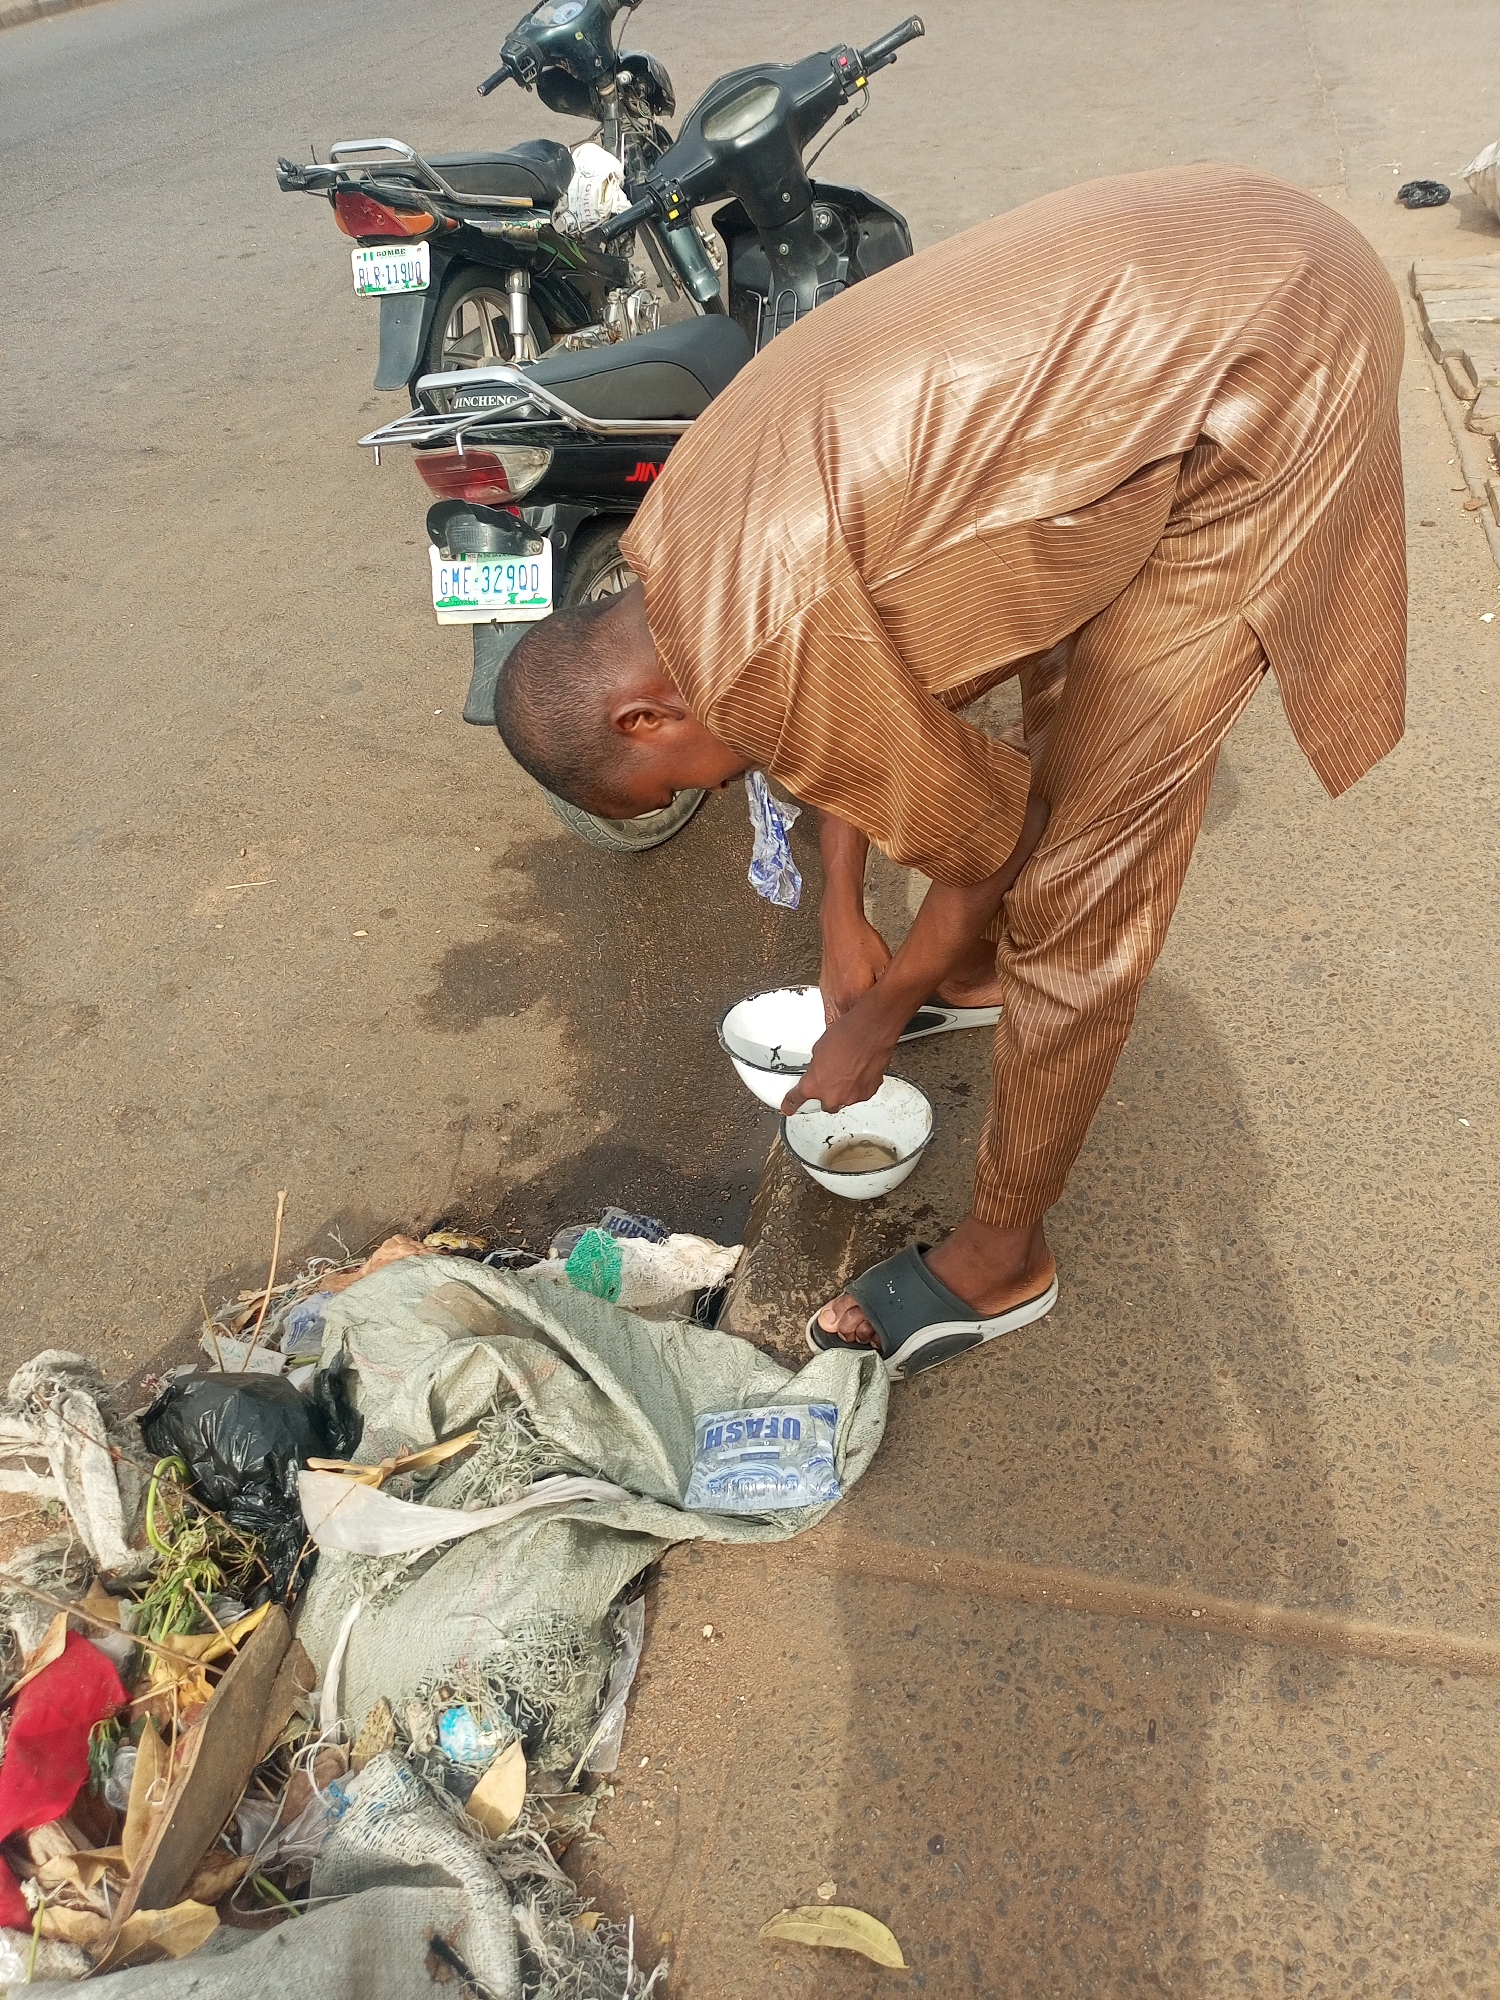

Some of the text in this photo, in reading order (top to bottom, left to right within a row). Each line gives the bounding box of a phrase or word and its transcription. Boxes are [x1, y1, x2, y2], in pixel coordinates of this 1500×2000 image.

[376, 248, 406, 257] GOMBE
[453, 395, 518, 410] JINCHENG
[705, 1417, 801, 1450] UFASH
